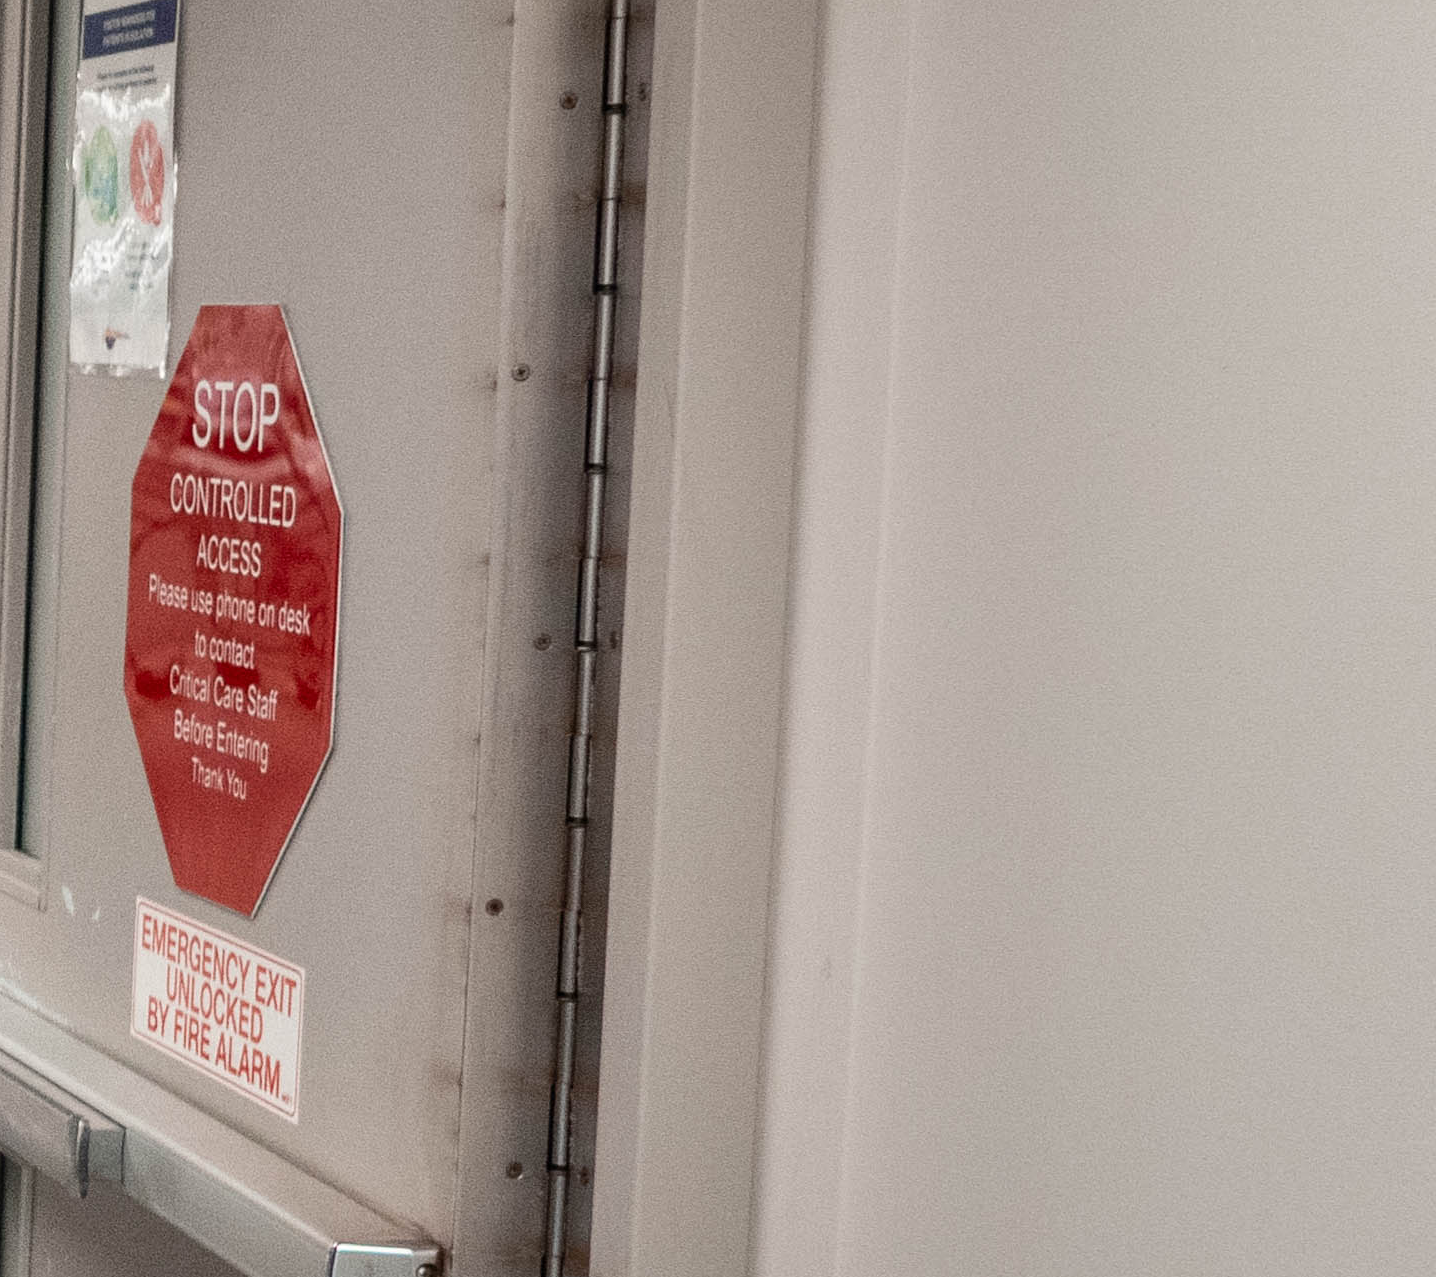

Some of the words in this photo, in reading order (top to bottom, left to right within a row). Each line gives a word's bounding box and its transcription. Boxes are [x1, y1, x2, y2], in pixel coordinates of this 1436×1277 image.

[192, 380, 281, 454] STOP
[169, 474, 296, 528] CONTROLLED
[196, 534, 262, 579] ACCESS
[149, 574, 188, 610] Please
[191, 589, 213, 615] use
[216, 590, 255, 623] phone
[258, 603, 275, 627] on
[278, 602, 310, 636] desk
[194, 629, 206, 658] to
[209, 636, 255, 670] contact
[169, 665, 211, 702] Critical
[214, 676, 243, 712] Care
[247, 684, 278, 721] Staff
[174, 709, 213, 748] Before
[216, 721, 268, 773] Entering
[192, 757, 223, 792] Thank
[227, 769, 247, 800] You
[142, 914, 250, 993] EMERGENCY
[255, 964, 296, 1018] EXIT
[166, 964, 263, 1044] UNLOCKED
[148, 996, 169, 1036] BY
[174, 1010, 210, 1061] FIRE
[215, 1032, 281, 1098] ALARM
